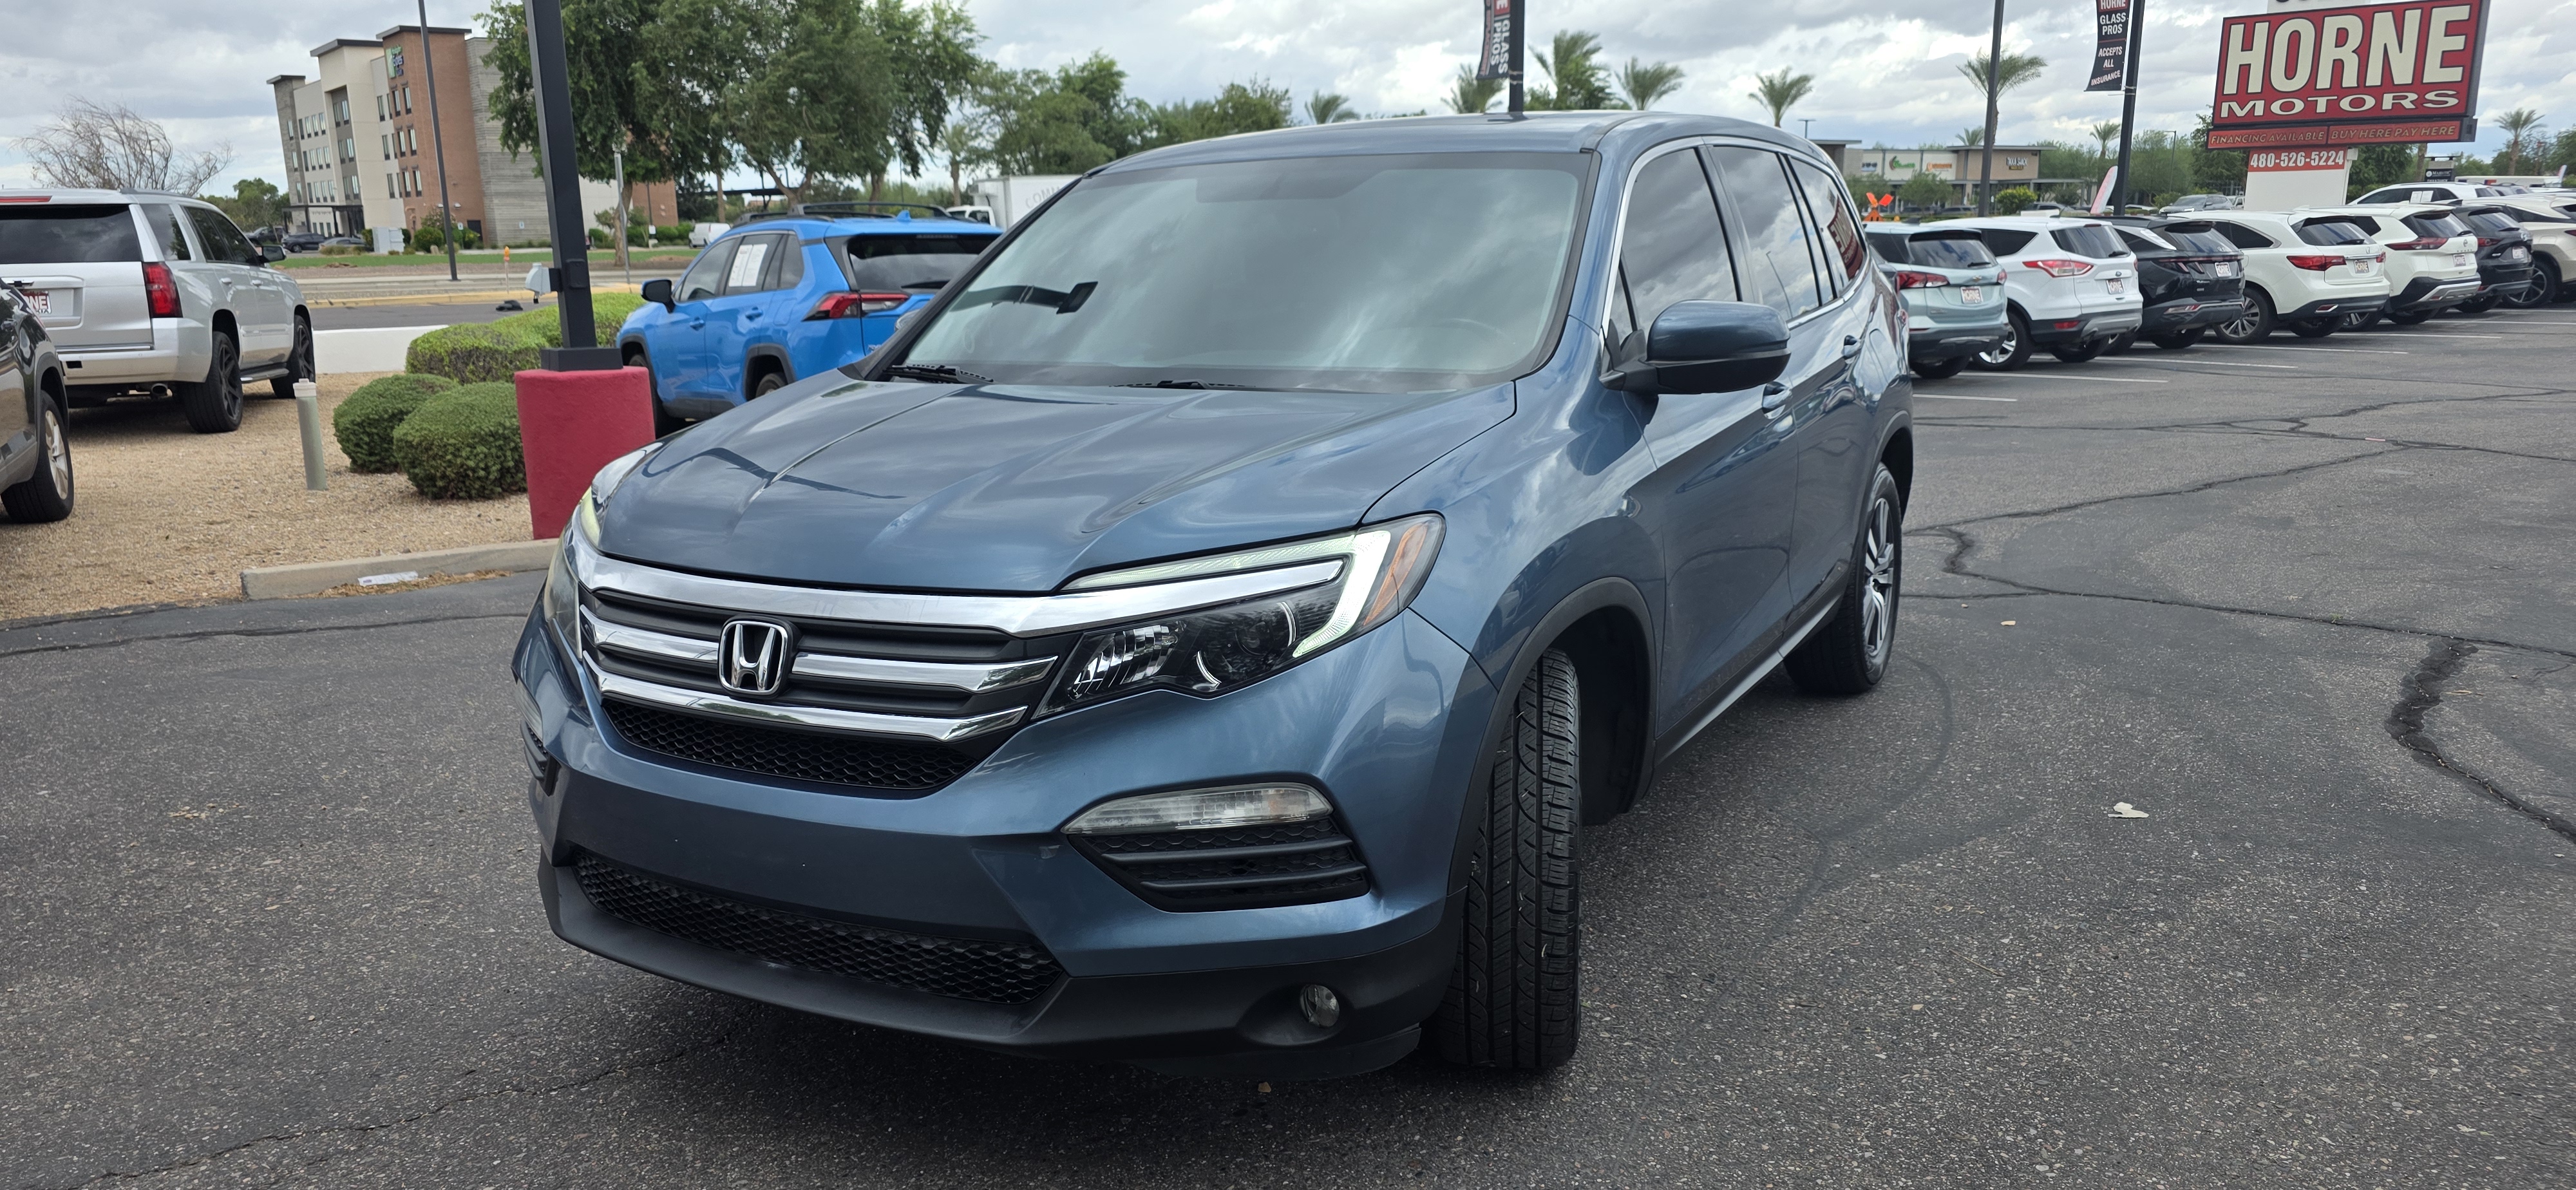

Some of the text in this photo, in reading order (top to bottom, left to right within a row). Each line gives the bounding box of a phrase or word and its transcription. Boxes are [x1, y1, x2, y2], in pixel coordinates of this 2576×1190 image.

[2099, 12, 2126, 24] GLASS
[2102, 24, 2123, 35] PROS
[1498, 19, 1510, 73] GLASS
[2098, 46, 2123, 57] ACCEPTS
[2224, 5, 2470, 95] HORNE
[2103, 59, 2114, 68] ALL
[2091, 70, 2121, 86] INSURANCE
[2221, 91, 2459, 118] MOTORS
[2211, 131, 2324, 144] FINANCING AVAILABLE
[2331, 126, 2455, 139] BUY HERE PAY HERE
[2250, 150, 2344, 167] 480-526-5224
